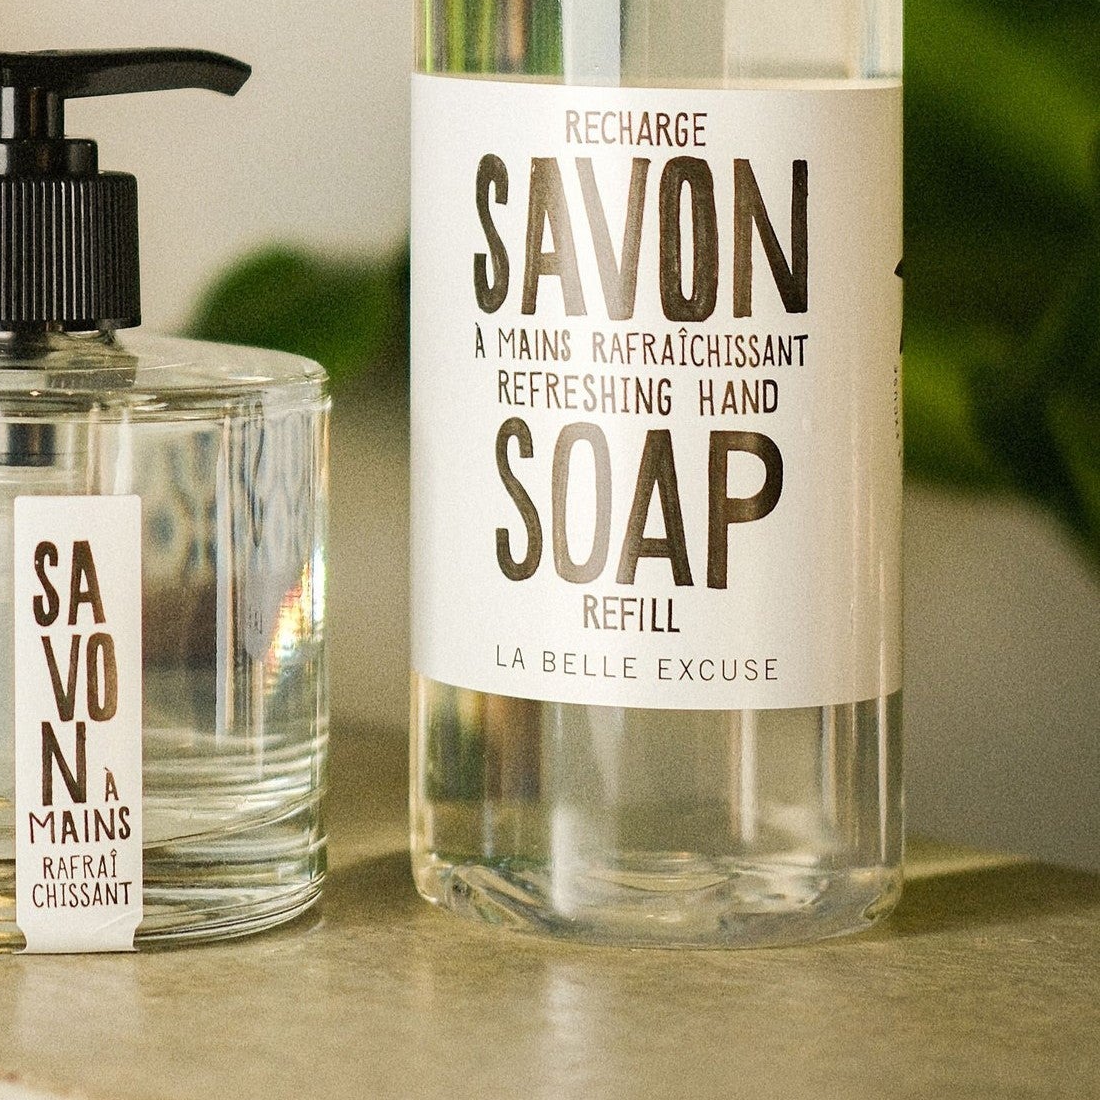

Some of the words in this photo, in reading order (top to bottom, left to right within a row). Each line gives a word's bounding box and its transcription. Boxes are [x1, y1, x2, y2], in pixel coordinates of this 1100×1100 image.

[566, 109, 708, 147] RECHARGE
[473, 153, 809, 322] SAVON
[474, 322, 486, 359] À
[498, 327, 571, 362] MAINS
[592, 326, 809, 368] RAFRAÎCHISSANT
[498, 369, 672, 416] REFRESHING
[699, 378, 779, 417] HAND
[495, 416, 784, 590] SOAP
[32, 540, 107, 628] SA
[583, 594, 682, 633] REFILL
[40, 631, 118, 722] VO
[496, 644, 526, 670] LA
[542, 650, 638, 679] BELLE
[658, 657, 779, 682] EXCUSE
[41, 721, 87, 807] N
[104, 766, 120, 803] À
[28, 805, 132, 845] MAINS
[42, 848, 118, 880] RAFRAÎ
[31, 881, 133, 909] CHISSANT
